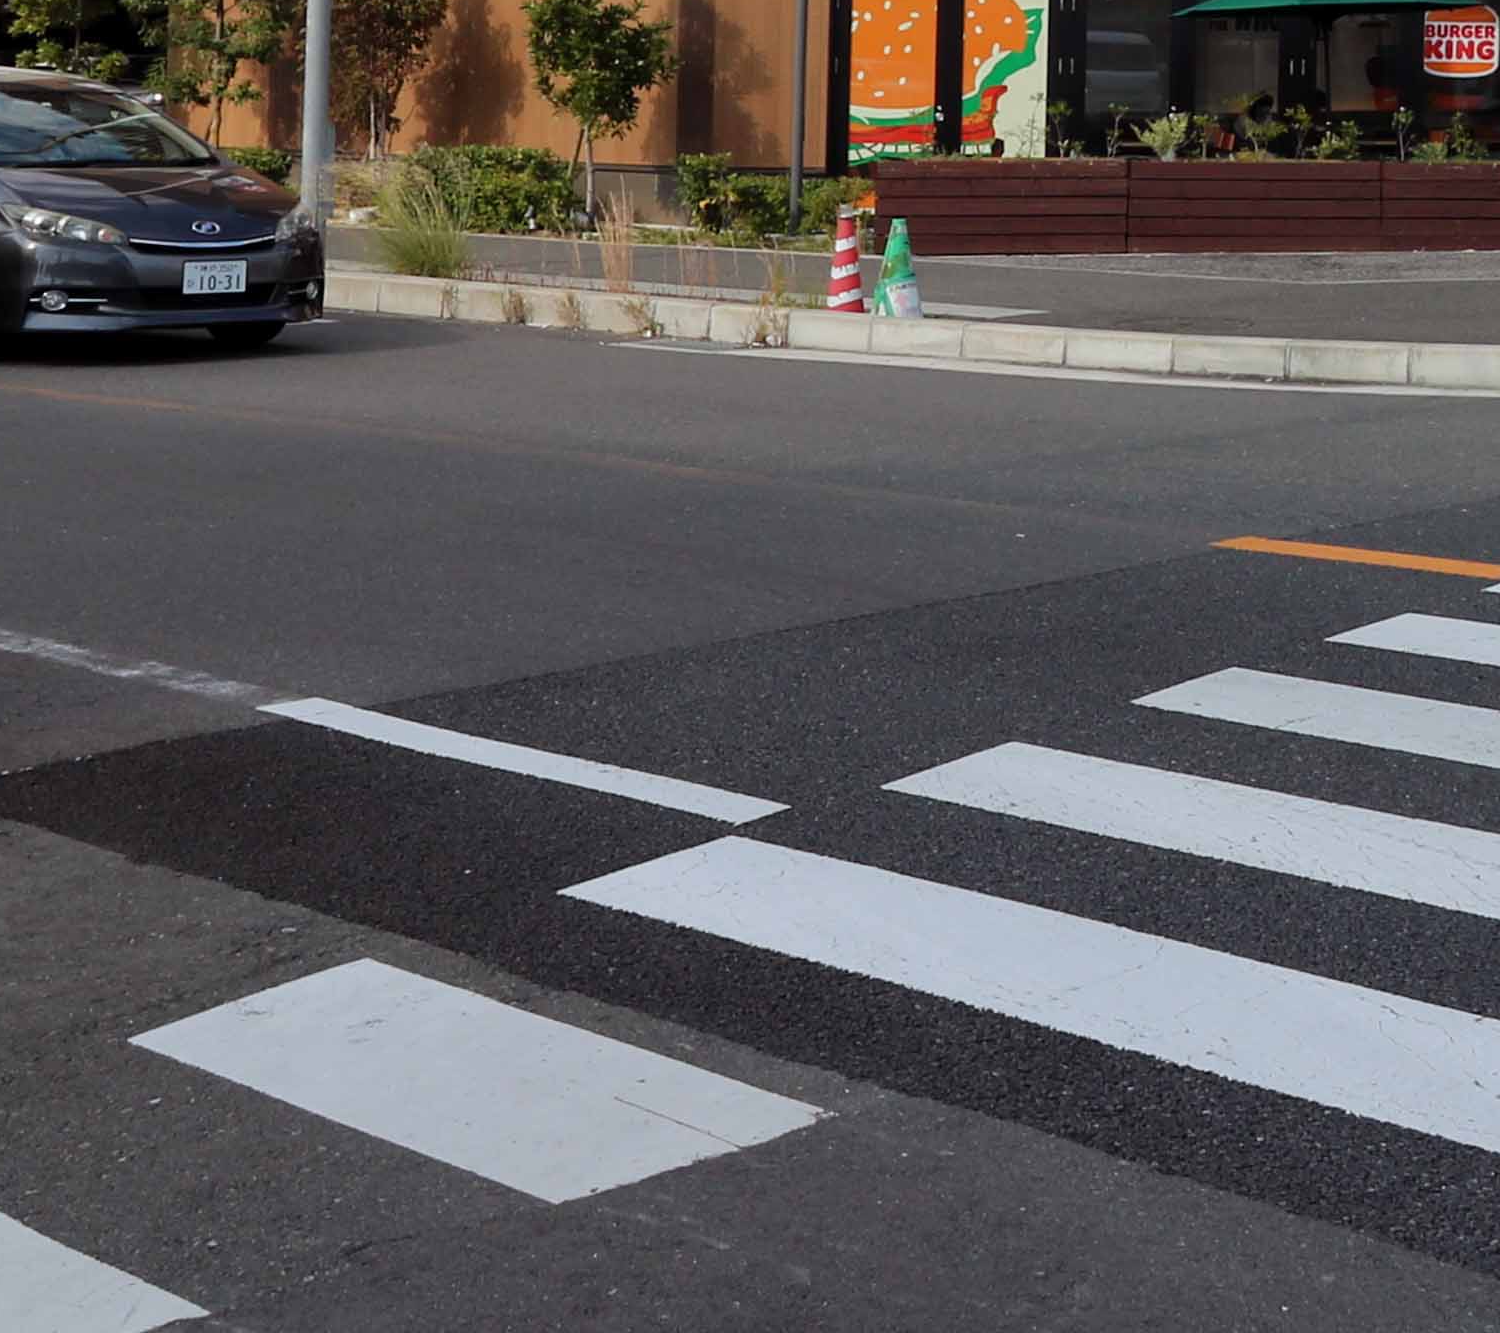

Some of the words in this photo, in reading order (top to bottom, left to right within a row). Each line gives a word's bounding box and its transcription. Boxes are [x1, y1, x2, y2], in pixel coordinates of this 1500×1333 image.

[1425, 23, 1496, 39] BURGER
[1425, 39, 1496, 60] KING
[199, 273, 241, 291] 10-31
